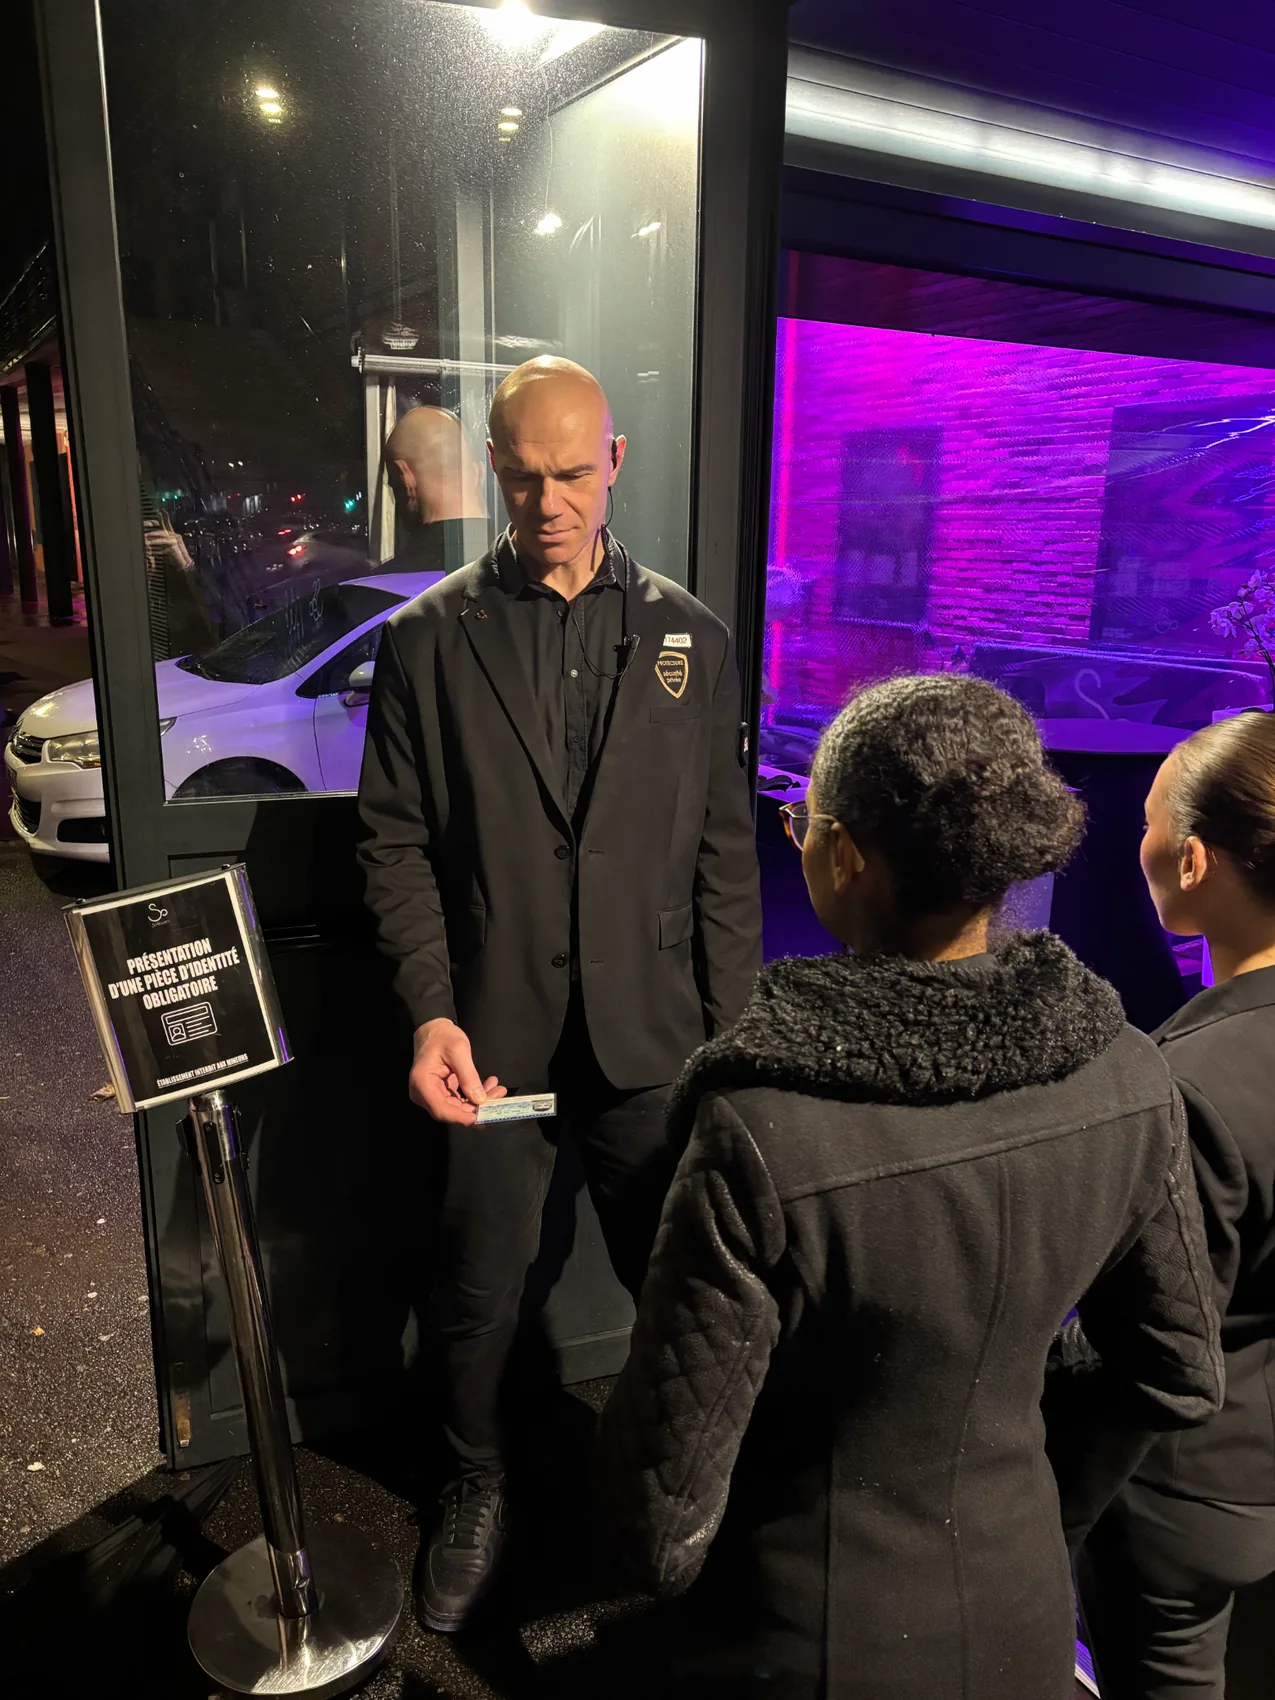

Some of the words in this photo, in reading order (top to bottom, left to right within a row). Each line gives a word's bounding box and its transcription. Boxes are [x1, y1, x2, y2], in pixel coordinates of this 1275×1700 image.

[108, 979, 145, 1000] D'UNE
[144, 965, 179, 991] PIÈCE
[178, 946, 241, 982] D'IDENTITÉ
[126, 937, 213, 975] PRÉSENTATION
[142, 975, 219, 1010] OBLIGATOIRE
[156, 1069, 195, 1088] ÉTABLISSEMENT
[194, 1062, 217, 1077] INTERDIT
[216, 1059, 227, 1070] AUX
[226, 1053, 249, 1066] MINEURS
